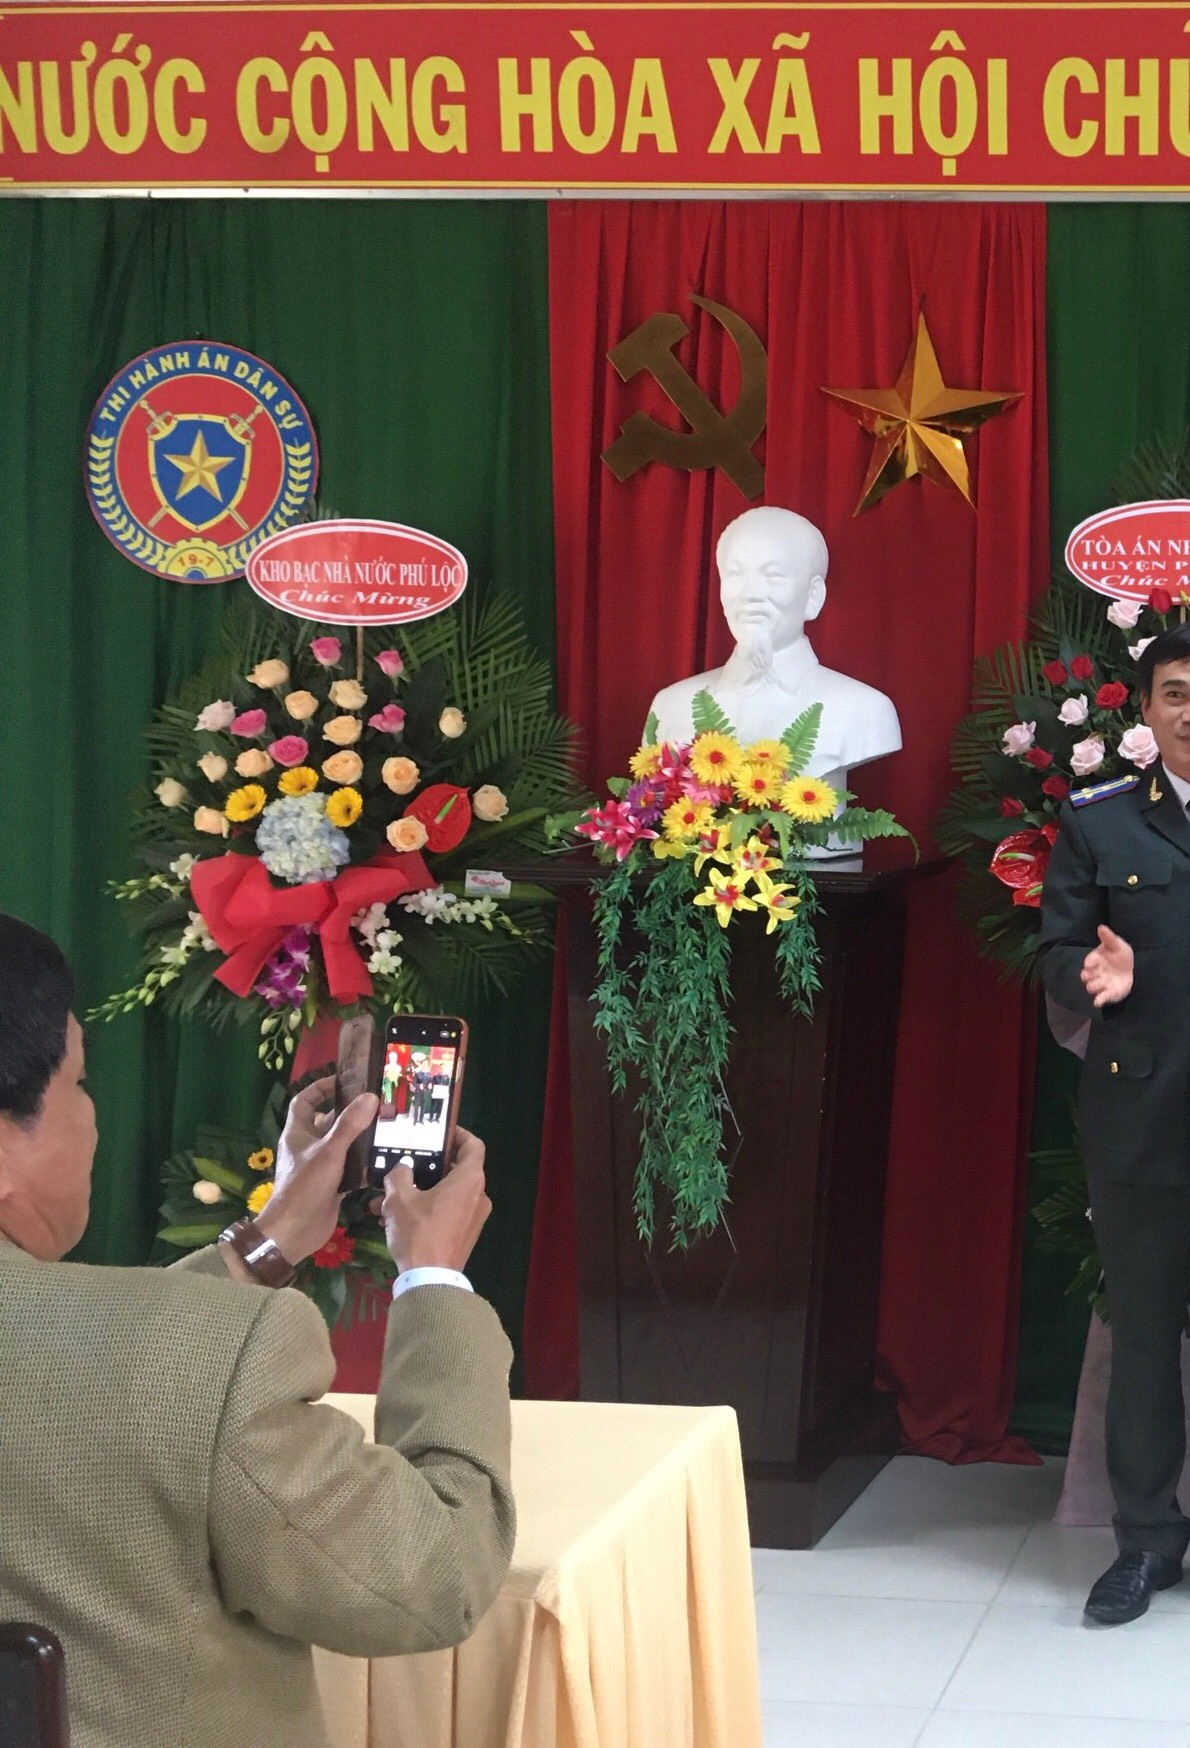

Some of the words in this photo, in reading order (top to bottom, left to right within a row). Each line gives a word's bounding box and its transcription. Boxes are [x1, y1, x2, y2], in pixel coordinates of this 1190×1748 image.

[0, 33, 207, 154] NƯỚC
[236, 31, 467, 172] CỘNG
[498, 30, 678, 154] HÒA
[707, 31, 821, 154] XÃ
[858, 29, 1008, 176] HỘI
[100, 386, 131, 423] THI
[128, 351, 190, 388] HÀNH
[197, 347, 230, 372] ÁN
[233, 363, 279, 400] DÂN
[274, 399, 304, 430] SỰ
[1081, 535, 1127, 556] TÒA
[1131, 535, 1162, 556] ÁN
[259, 559, 291, 582] KHO
[293, 560, 321, 589] BẠC
[323, 555, 352, 584] NHÀ
[354, 556, 396, 586] NƯỚC
[399, 557, 428, 587] PHÚ
[431, 561, 461, 593] LỘC
[1099, 574, 1169, 587] Chúc
[279, 588, 345, 604] Chúc
[353, 590, 432, 609] Mừng
